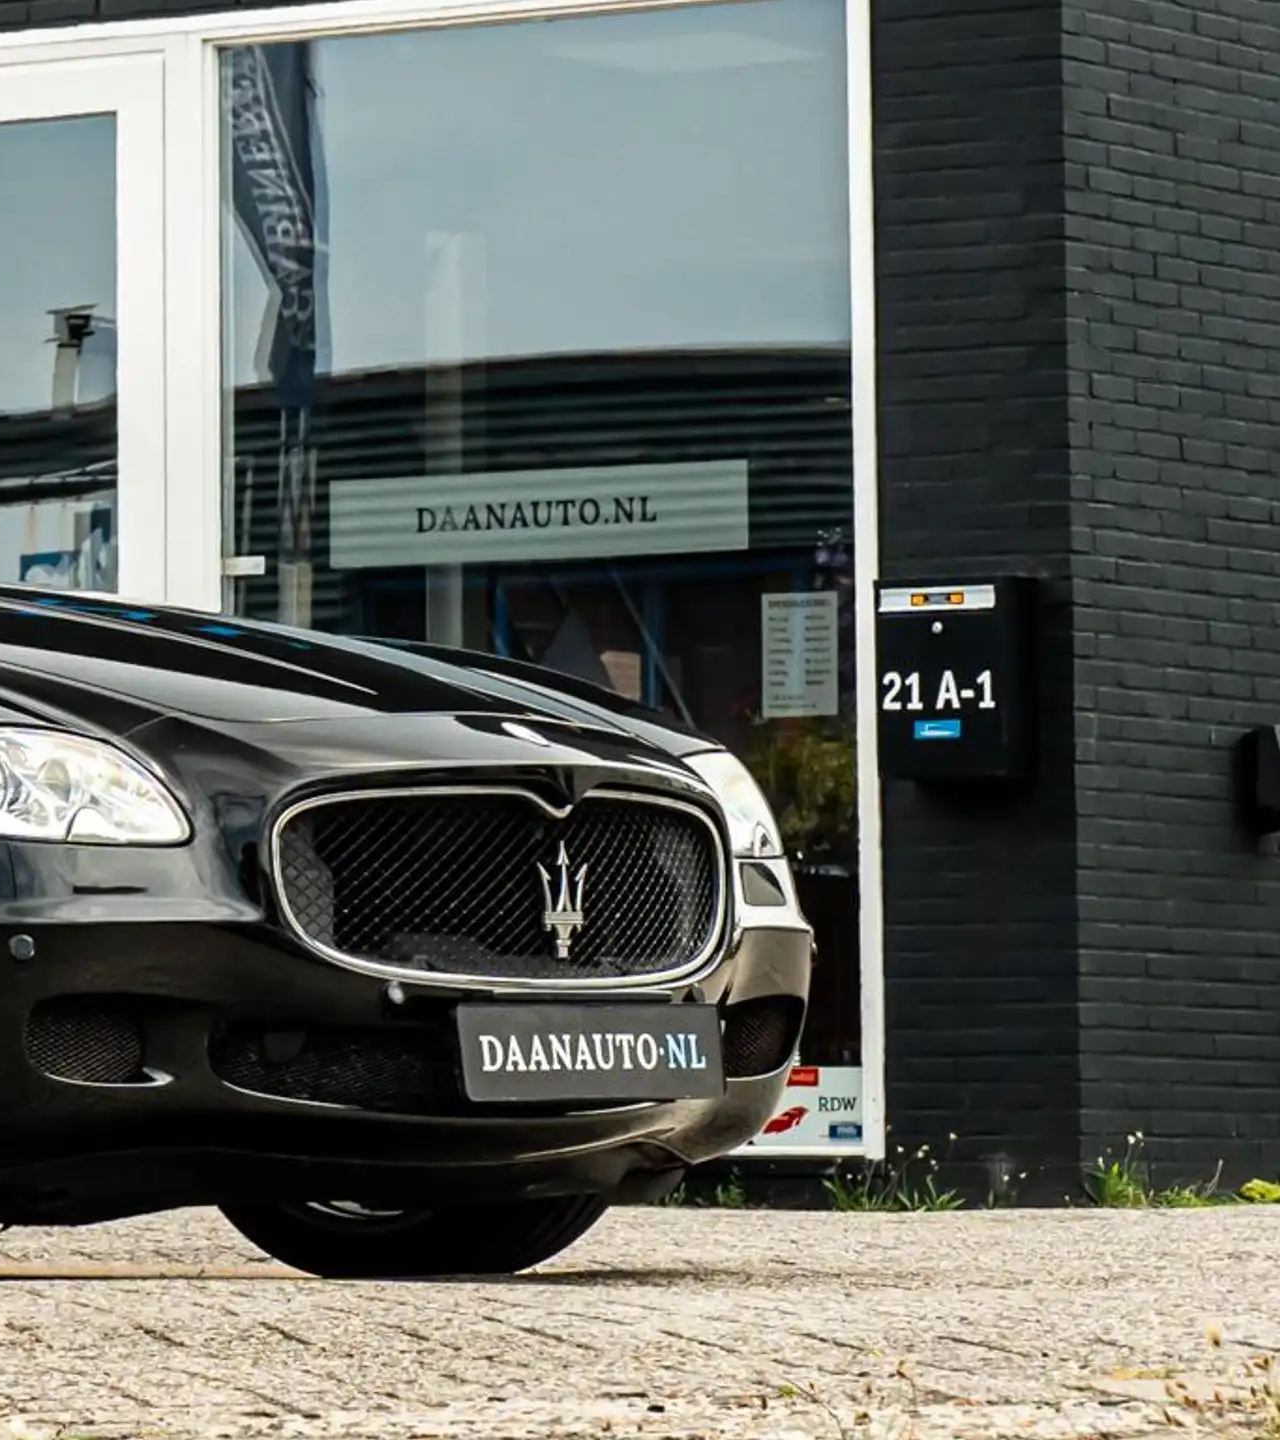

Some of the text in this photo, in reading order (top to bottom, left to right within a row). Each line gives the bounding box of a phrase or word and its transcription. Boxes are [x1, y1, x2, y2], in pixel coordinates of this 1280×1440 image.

[416, 496, 657, 533] DAANAUTO.NL
[882, 669, 996, 711] 21 A-1
[818, 1096, 858, 1112] RDW
